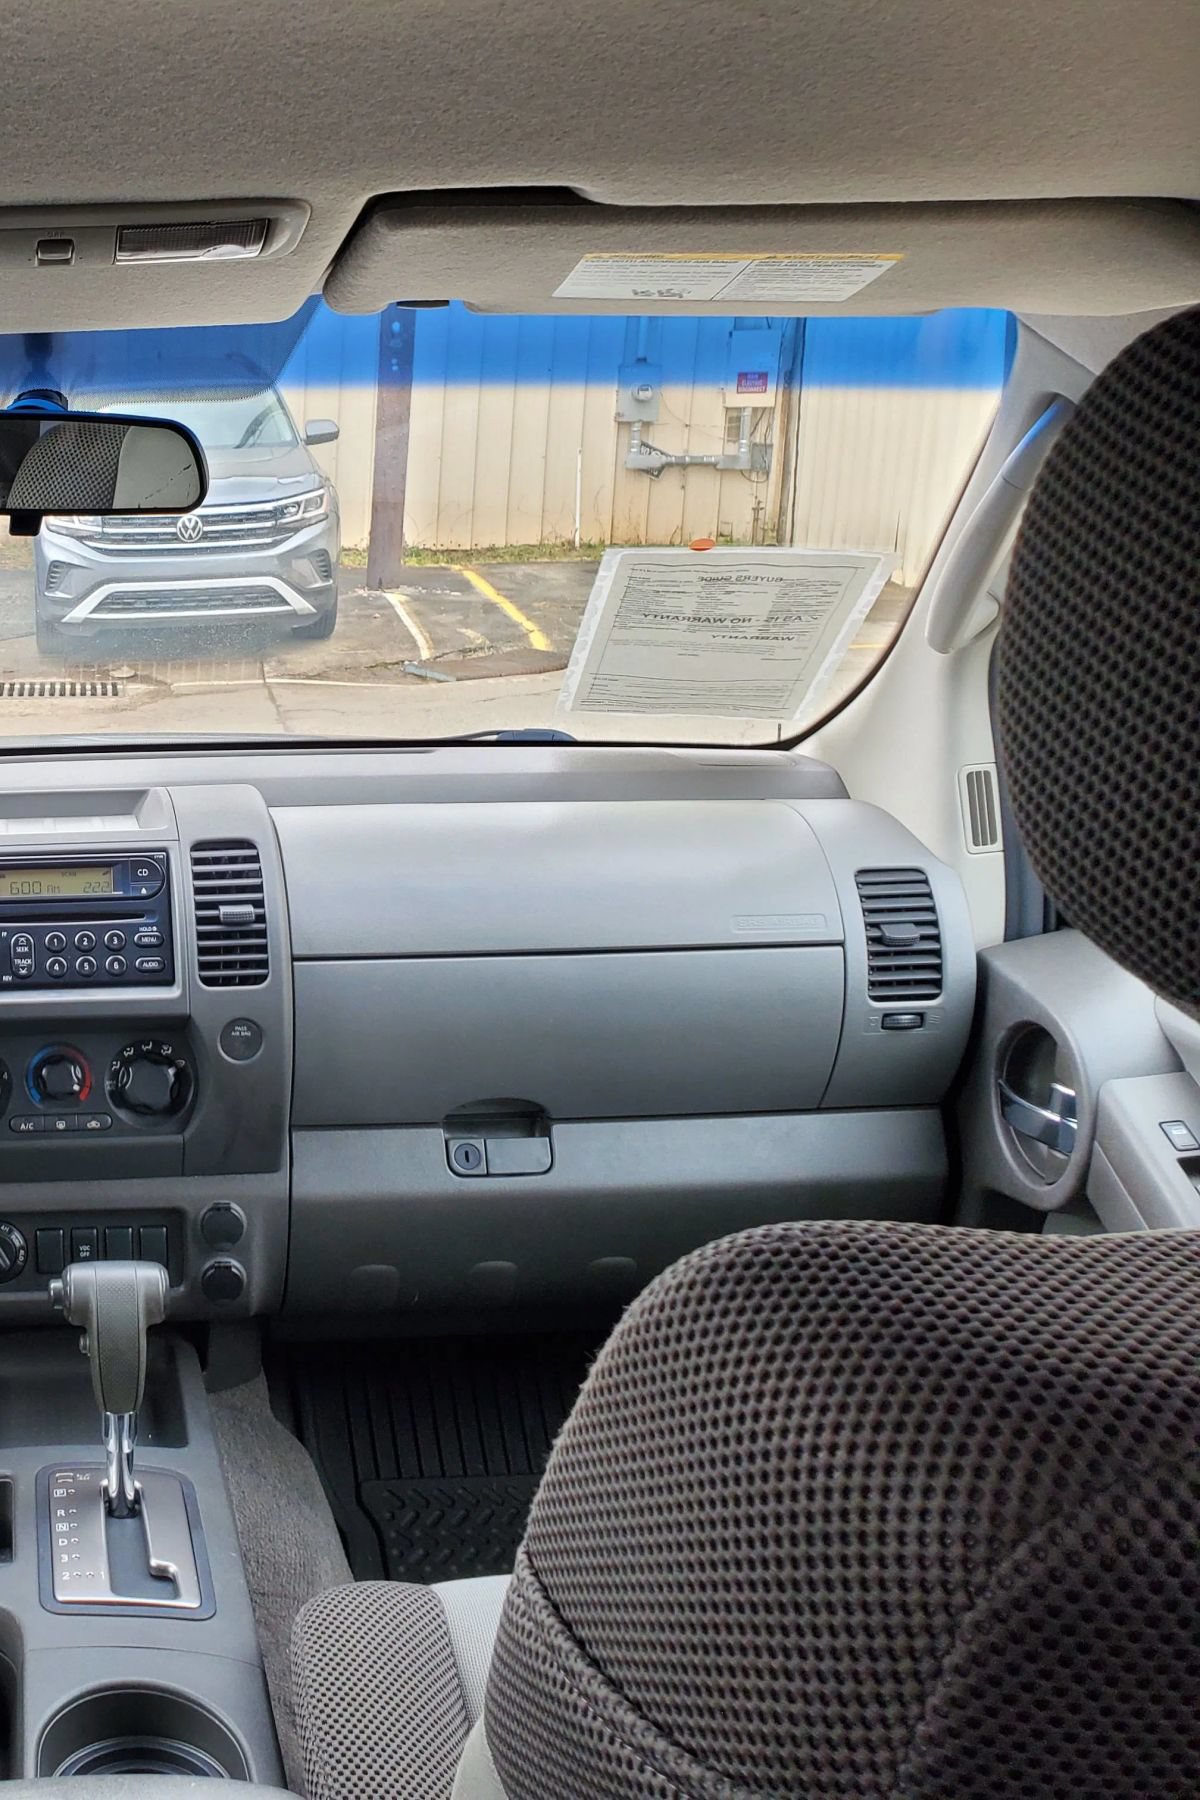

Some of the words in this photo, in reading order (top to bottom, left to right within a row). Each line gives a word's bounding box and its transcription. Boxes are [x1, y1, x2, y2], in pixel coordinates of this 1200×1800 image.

[137, 868, 149, 876] CD
[9, 880, 42, 895] 600
[53, 938, 58, 946] 1
[112, 936, 118, 945] 3
[53, 963, 59, 971] 4
[84, 962, 89, 970] 5
[113, 961, 119, 970] 6
[2, 1071, 8, 1080] 4
[20, 1122, 34, 1130] A/C
[57, 1509, 66, 1518] R
[58, 1538, 68, 1546] D
[60, 1553, 69, 1563] 3
[62, 1571, 71, 1581] 2
[100, 1571, 105, 1581] 1
